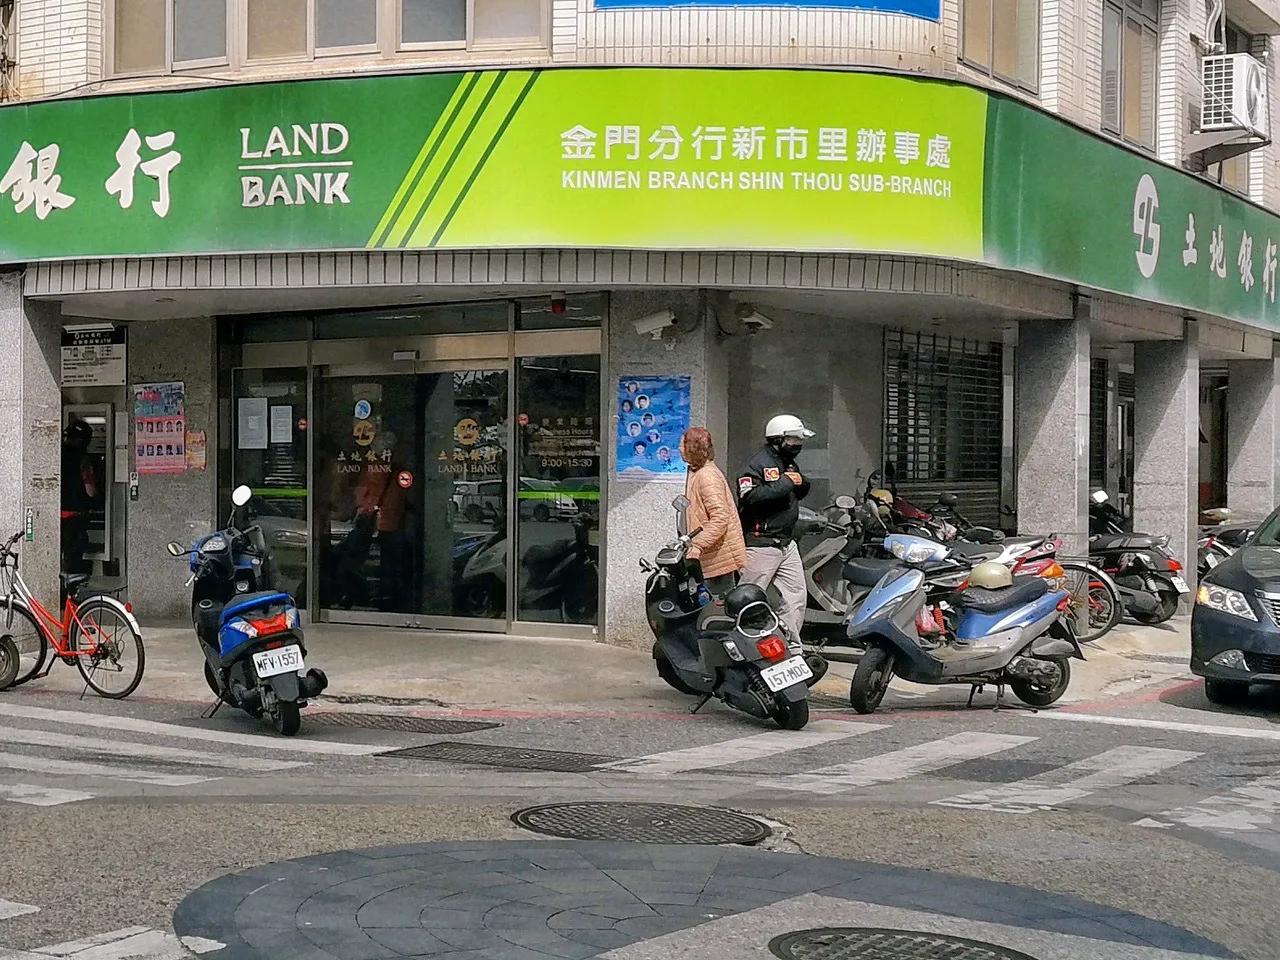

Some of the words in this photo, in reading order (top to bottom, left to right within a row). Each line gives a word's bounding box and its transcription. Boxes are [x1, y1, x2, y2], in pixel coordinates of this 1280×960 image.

[240, 123, 349, 159] LAND
[560, 124, 952, 169] 金門分行新市里辦事處
[240, 171, 351, 207] BANK
[561, 171, 641, 190] KINMEN
[648, 171, 733, 190] BRANCH
[738, 172, 784, 190] SHIN
[791, 172, 842, 192] THOU
[848, 174, 952, 198] SUB-BRANCH
[1182, 213, 1278, 303] 土地銀行
[337, 465, 361, 473] LAND
[367, 464, 393, 473] BANK
[438, 464, 463, 473] LAND
[470, 464, 498, 473] BANK
